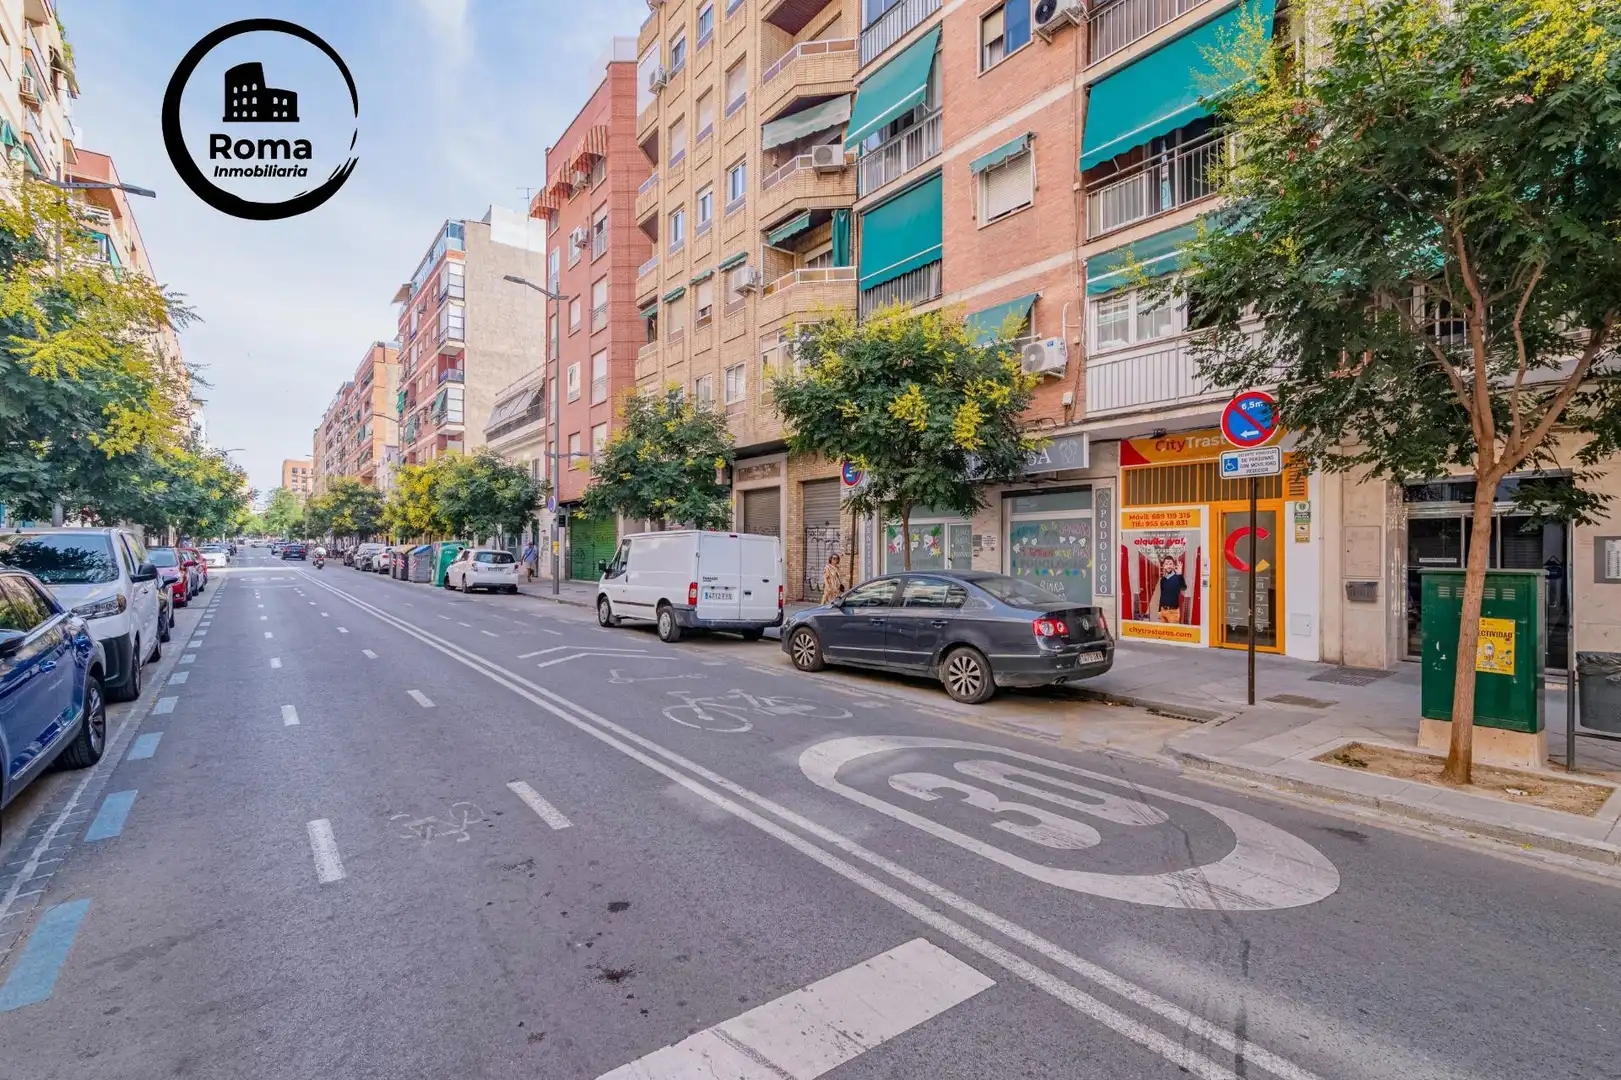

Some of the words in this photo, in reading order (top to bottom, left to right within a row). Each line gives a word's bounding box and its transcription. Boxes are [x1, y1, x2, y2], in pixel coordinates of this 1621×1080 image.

[1155, 436, 1226, 452] CityTrast
[1179, 511, 1191, 519] 315
[1134, 537, 1164, 546] alquila
[887, 758, 1170, 850] 30
